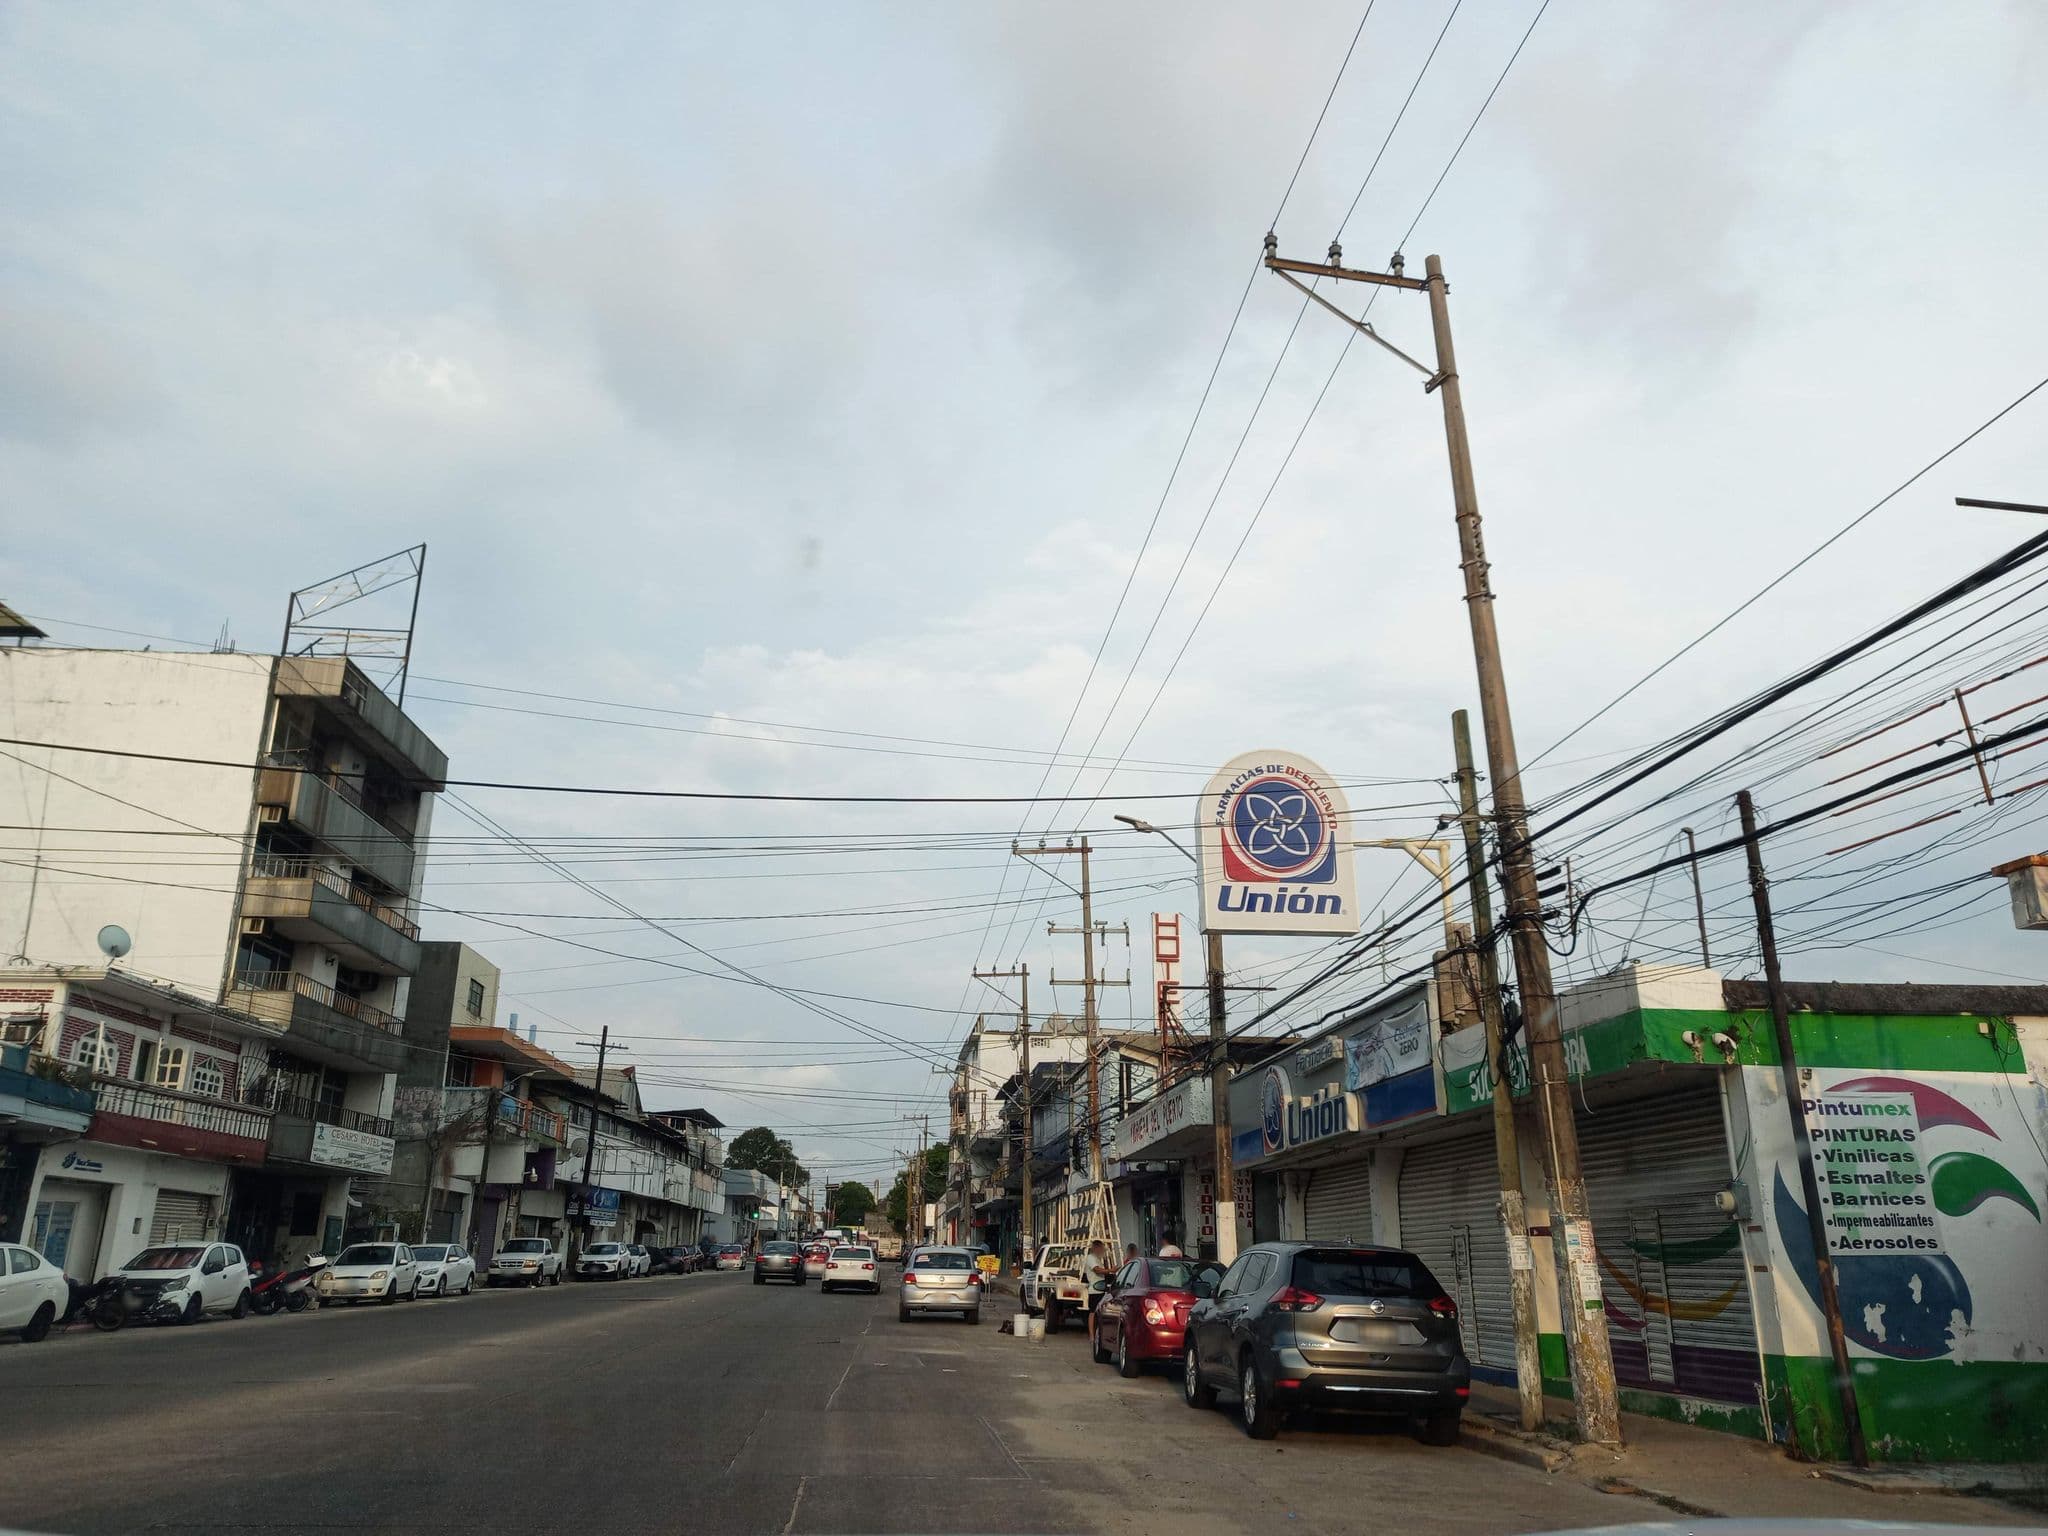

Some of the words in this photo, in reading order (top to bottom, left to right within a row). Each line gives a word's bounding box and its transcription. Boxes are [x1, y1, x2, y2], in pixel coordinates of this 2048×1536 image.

[1216, 765, 1264, 826] FARMACIAS
[1267, 764, 1285, 774] DE
[1285, 765, 1338, 830] DESCUENTO
[1217, 885, 1342, 915] Unión
[1399, 1037, 1419, 1056] ZERO
[1801, 1099, 1911, 1116] Pintumex
[1287, 1087, 1346, 1146] Unión
[1810, 1128, 1915, 1142] PINTURAS
[1822, 1148, 1915, 1163] Vinilicas
[1827, 1170, 1925, 1184] Esmaltes
[1237, 1169, 1245, 1218] INTURA
[1245, 1168, 1253, 1228] INILICA
[1831, 1191, 1926, 1206] Barnices
[1833, 1213, 1934, 1230] Impermeabilizantes
[1839, 1235, 1938, 1249] Aerosoles
